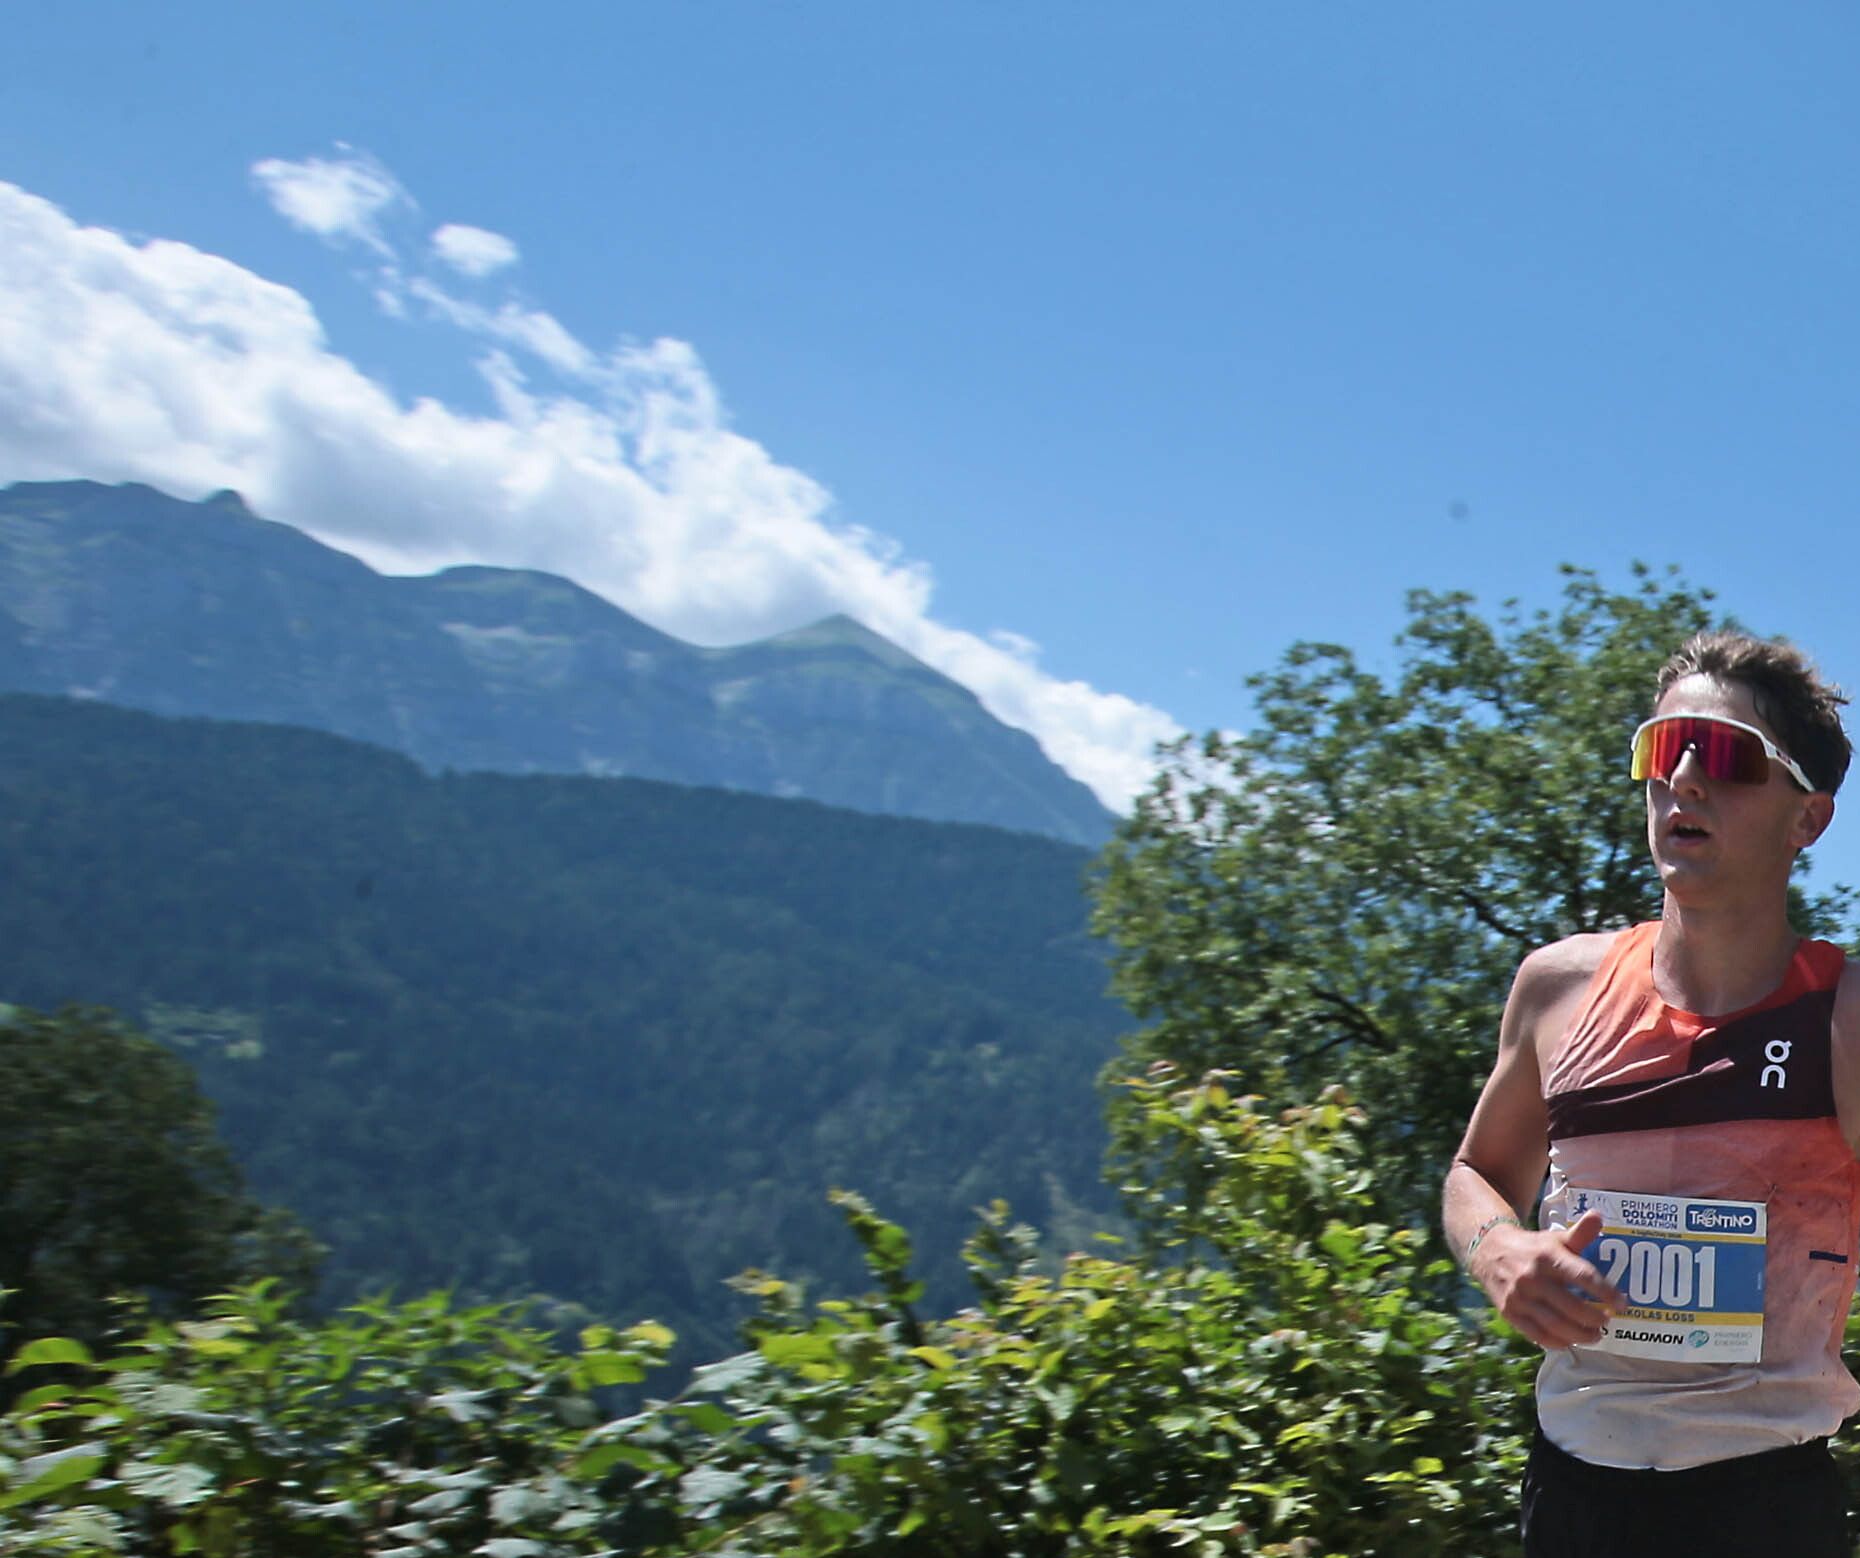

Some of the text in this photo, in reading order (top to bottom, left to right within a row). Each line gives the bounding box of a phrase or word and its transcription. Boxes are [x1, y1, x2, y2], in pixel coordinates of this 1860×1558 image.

[1621, 1199, 1679, 1213] PRIMIERO
[1622, 1209, 1678, 1222] DOLOMITI
[1690, 1210, 1753, 1229] TRENTINO
[1626, 1218, 1678, 1230] MARATHON
[1599, 1238, 1716, 1308] 2001
[1665, 1312, 1696, 1322] LOSS
[1614, 1329, 1684, 1345] SALOMON
